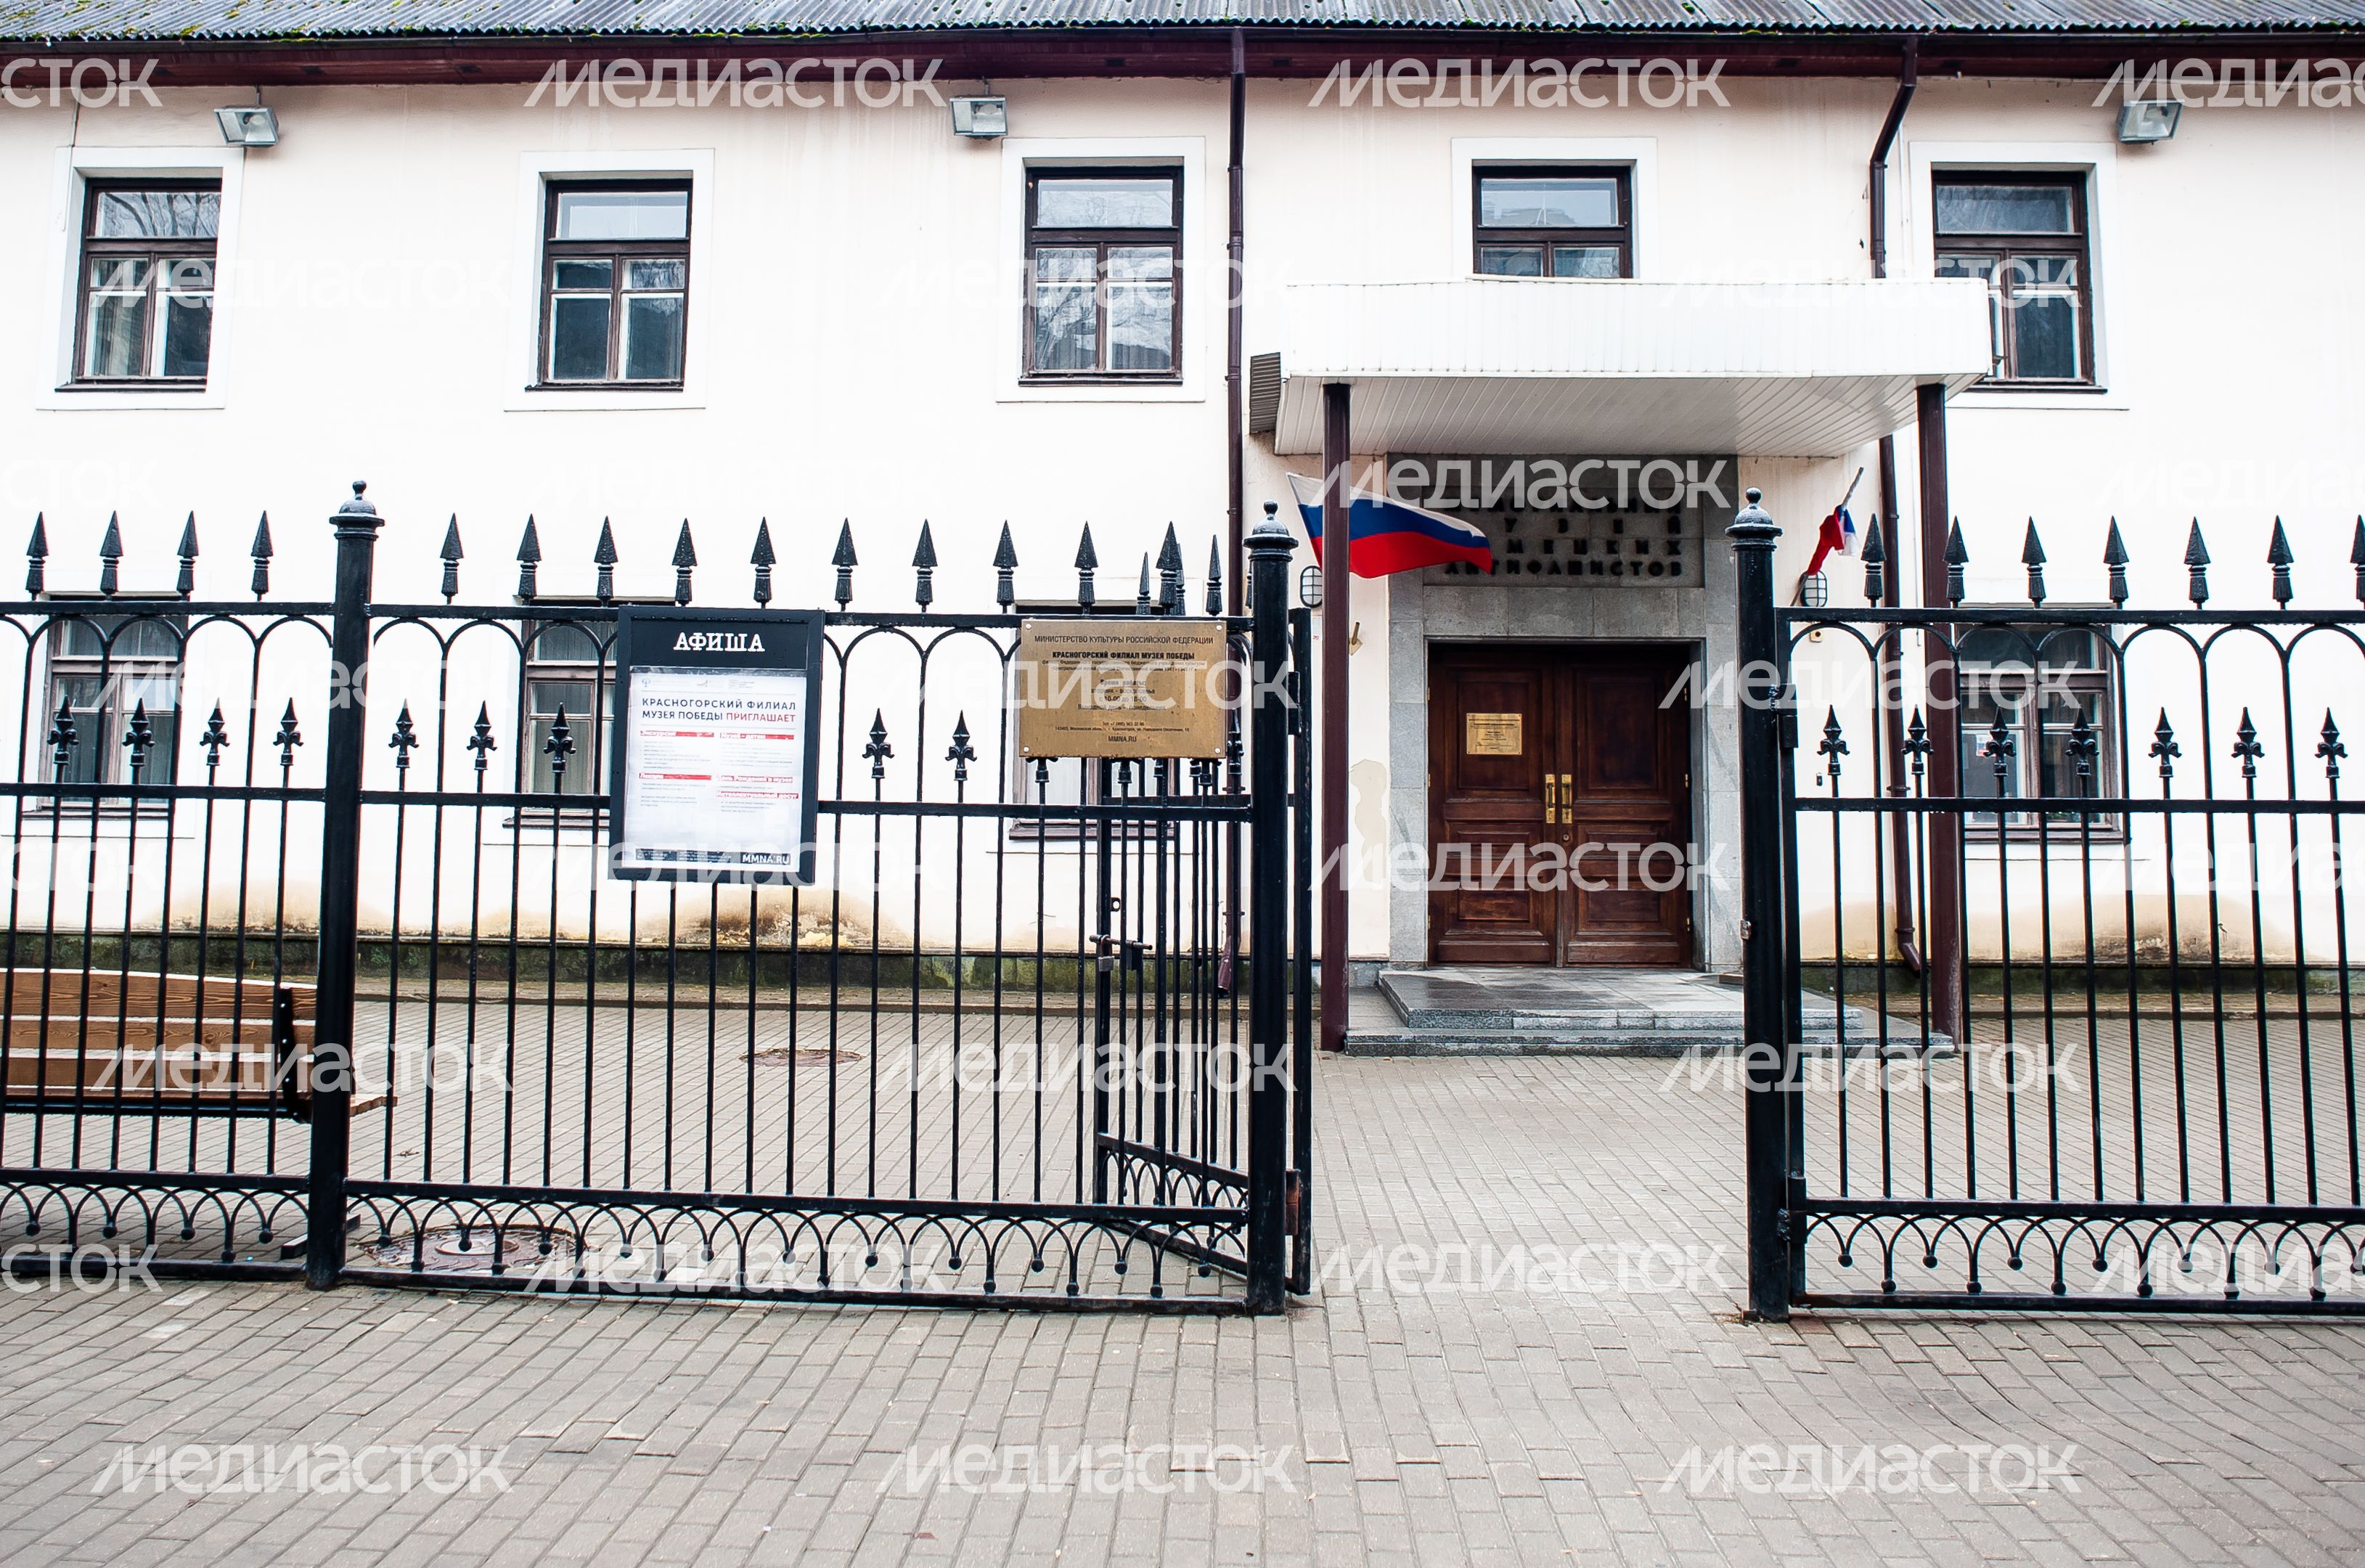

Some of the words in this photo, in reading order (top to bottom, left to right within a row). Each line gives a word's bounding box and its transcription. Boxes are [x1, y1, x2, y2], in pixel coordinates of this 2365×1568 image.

[1505, 515, 1681, 534] УЗЕЙ
[1506, 539, 1682, 555] МЕЦКИХ
[674, 632, 765, 652] АФИША
[642, 698, 742, 709] КРАСНОГОРСКИЙ
[747, 701, 796, 710] ФИЛИАЛ
[679, 711, 722, 720] ПОБЕДЫ
[727, 713, 796, 722] ПРИГЛАШАЕТ
[742, 853, 789, 864] MMNA.RU
